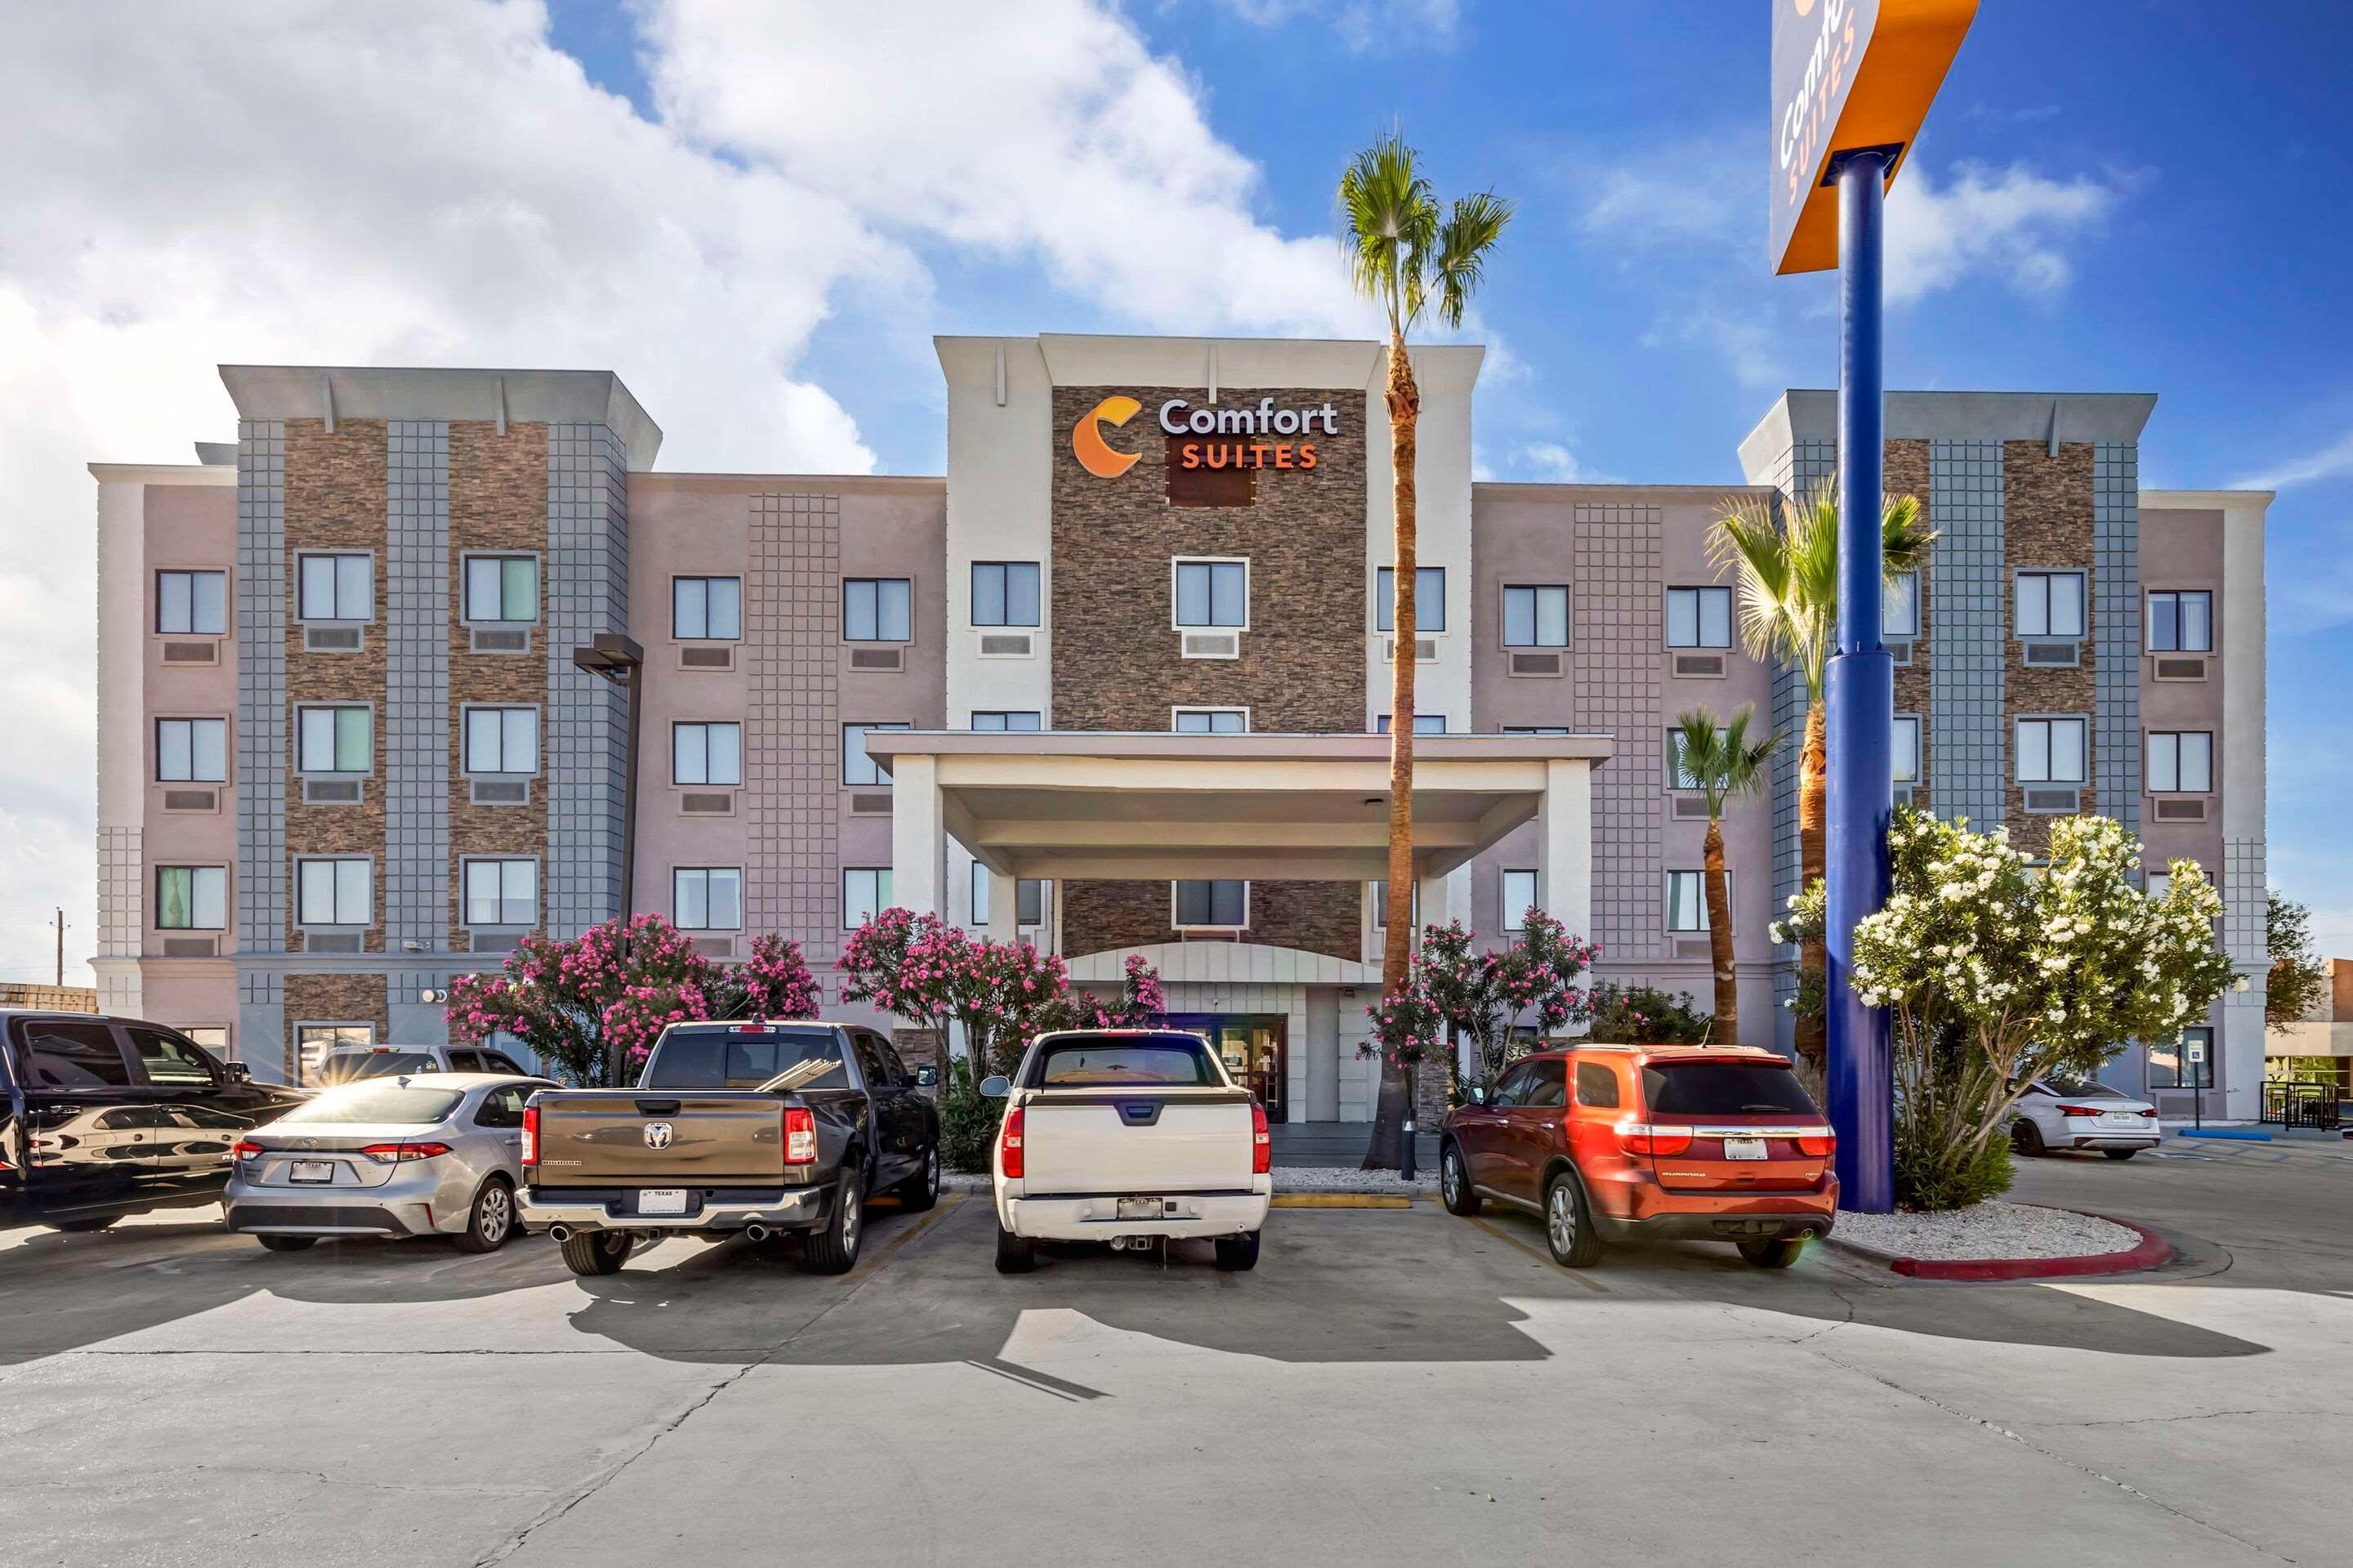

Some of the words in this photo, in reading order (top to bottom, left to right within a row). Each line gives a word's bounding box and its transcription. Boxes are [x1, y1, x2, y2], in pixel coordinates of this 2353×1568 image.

[1780, 0, 1844, 170] Comfo
[1788, 6, 1855, 207] SUITES
[1159, 397, 1338, 436] Comfort
[1181, 444, 1317, 470] SUITES
